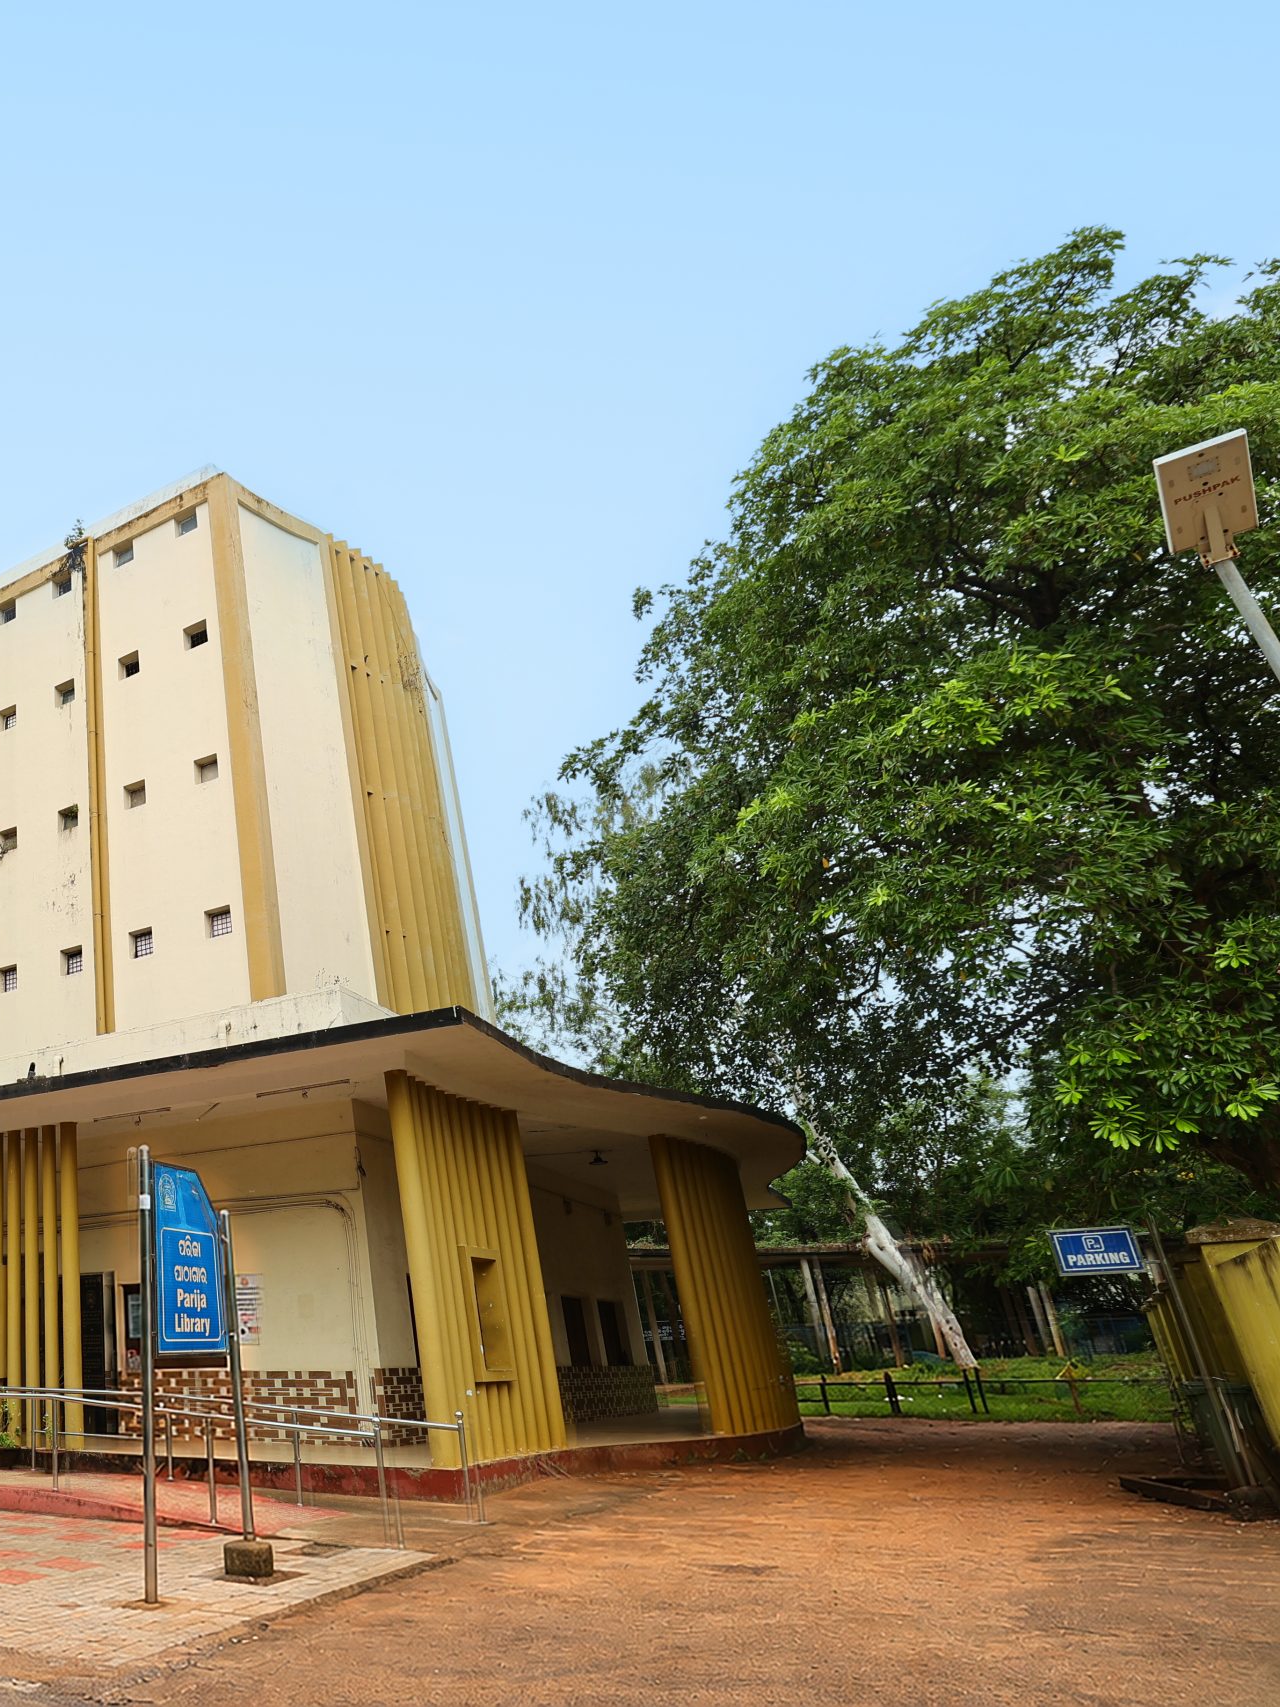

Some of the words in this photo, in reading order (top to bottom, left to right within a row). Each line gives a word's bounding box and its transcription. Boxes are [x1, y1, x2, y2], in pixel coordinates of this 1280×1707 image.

[1174, 476, 1241, 505] PUSHPAK
[1067, 1251, 1131, 1266] PARKING
[176, 1288, 207, 1312] Parija
[174, 1313, 210, 1337] Library
